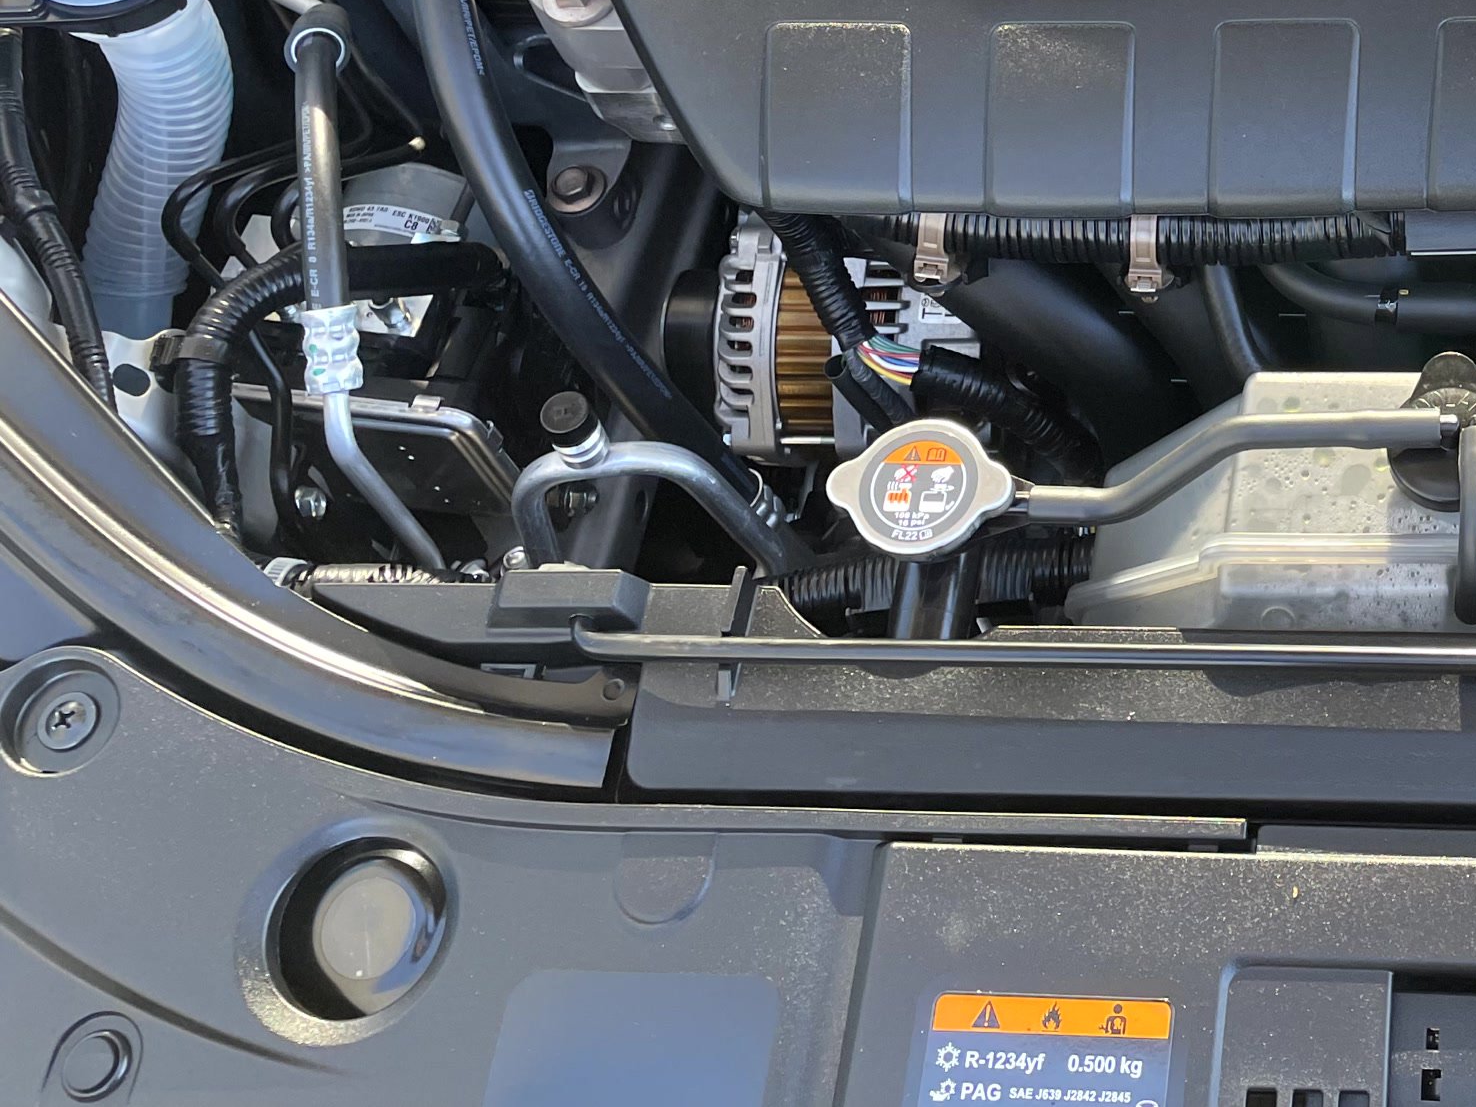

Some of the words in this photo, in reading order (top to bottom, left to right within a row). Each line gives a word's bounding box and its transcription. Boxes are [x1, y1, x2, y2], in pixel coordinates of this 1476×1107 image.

[310, 269, 320, 297] E-CR
[891, 529, 918, 541] FL22
[964, 1051, 1045, 1075] R-1234yf
[1067, 1054, 1116, 1074] 0.500
[1119, 1056, 1143, 1078] kg
[960, 1082, 1002, 1101] PAG
[1009, 1087, 1034, 1100] SAE
[1036, 1089, 1062, 1101] J639
[1064, 1089, 1097, 1102] J2842
[1098, 1091, 1131, 1104] J2845
